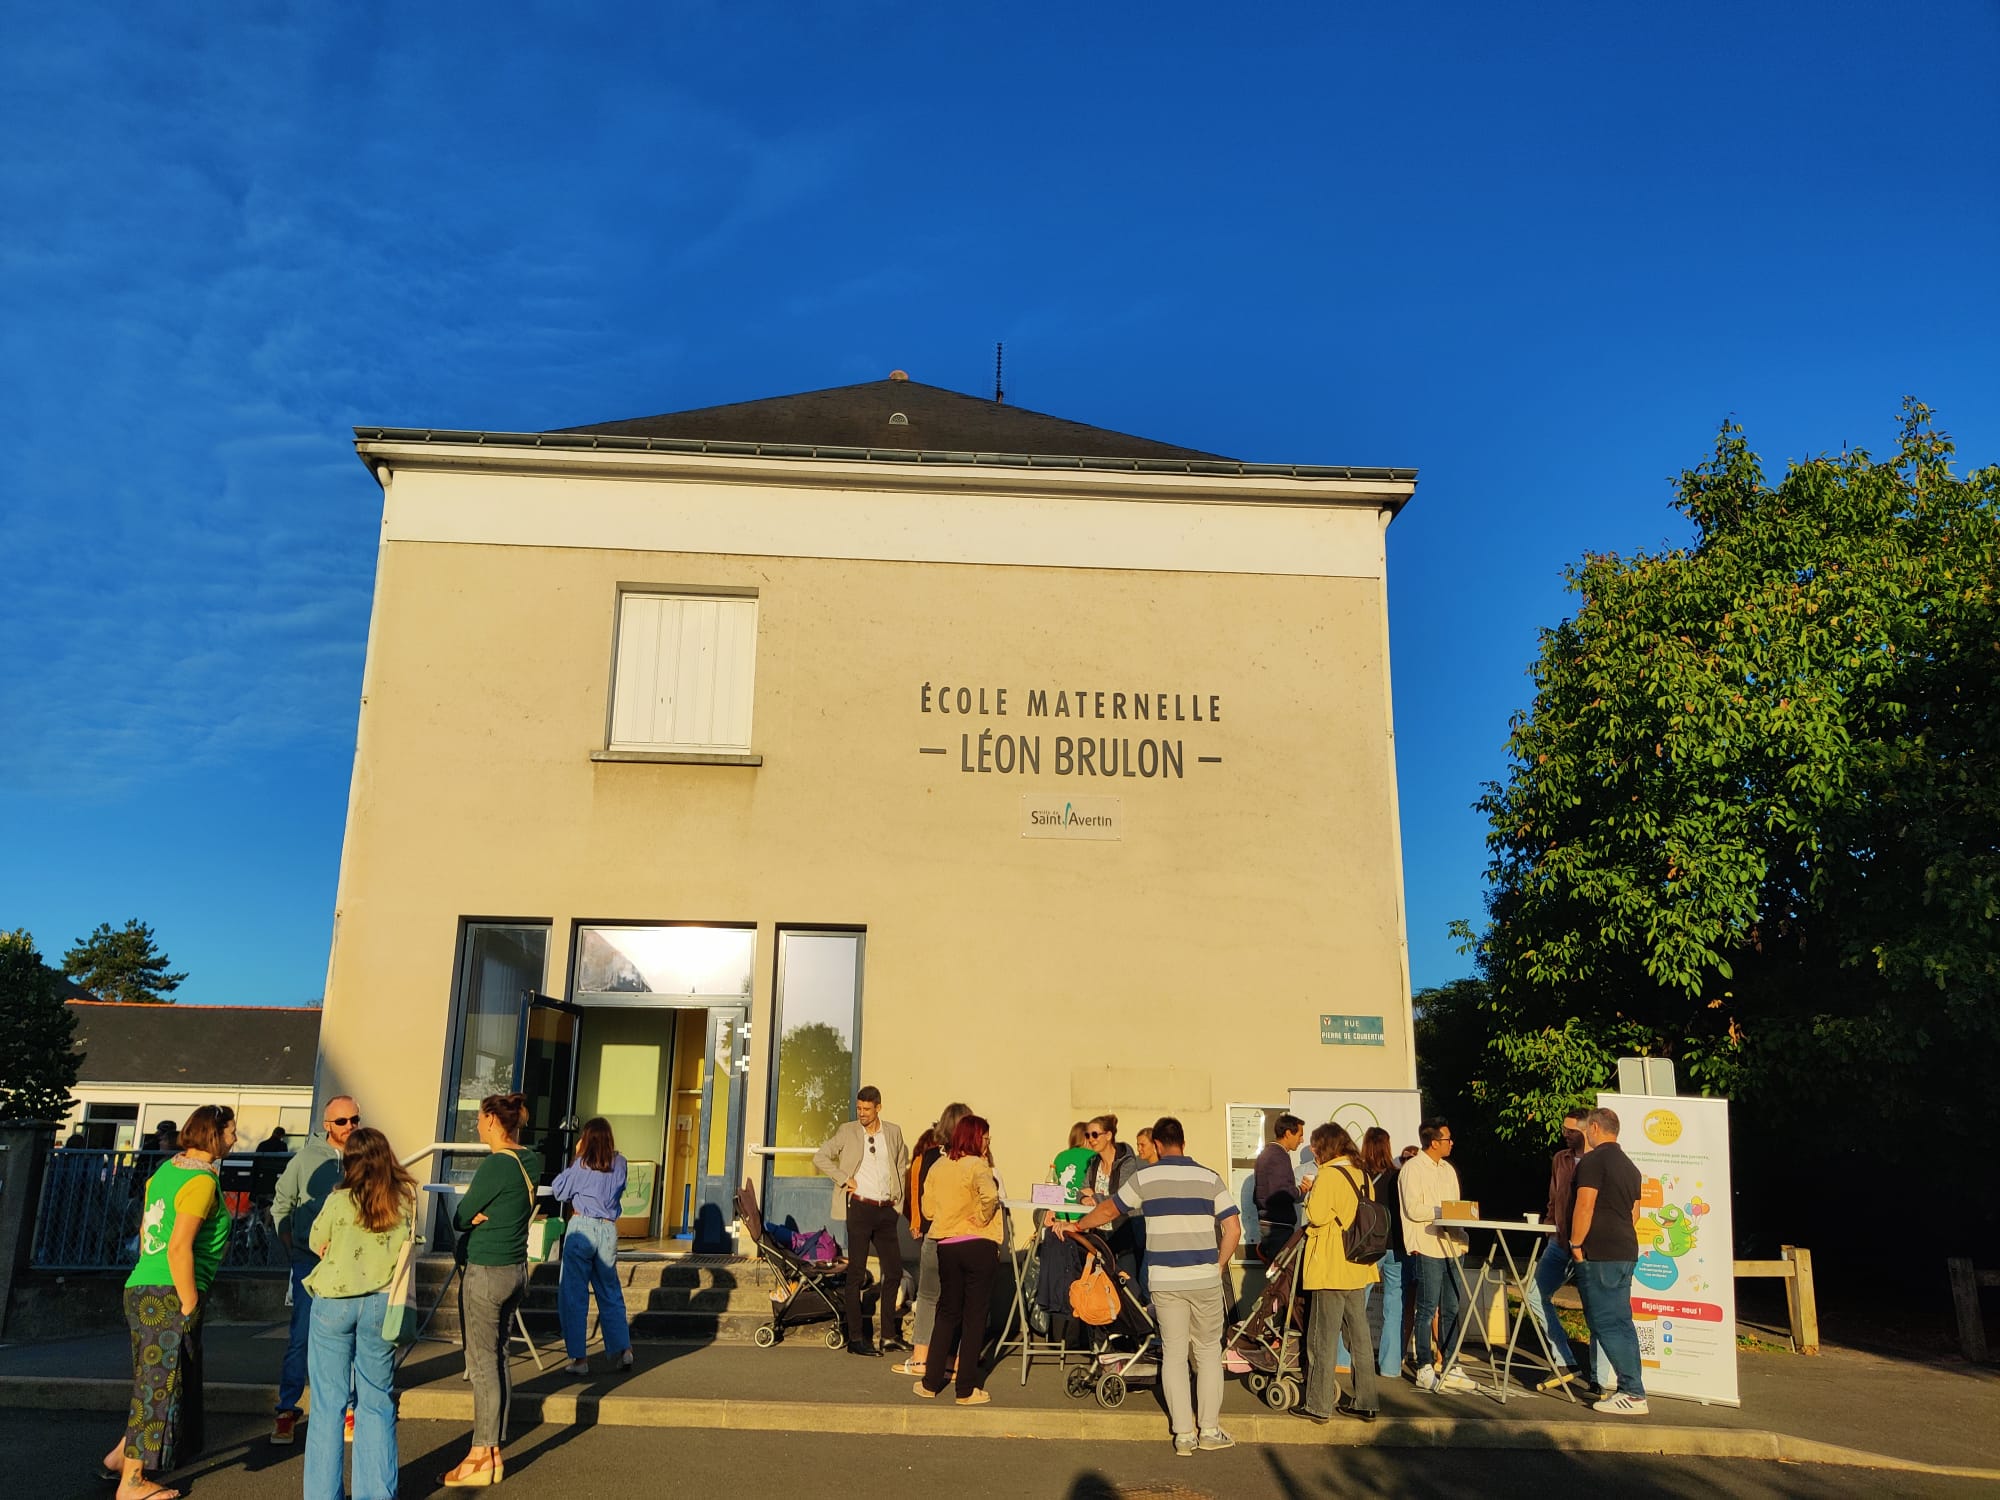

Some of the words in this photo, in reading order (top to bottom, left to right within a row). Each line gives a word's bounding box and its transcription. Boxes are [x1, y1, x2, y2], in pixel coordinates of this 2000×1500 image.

[920, 682, 1007, 716] ÉCOLE
[1026, 689, 1221, 722] MATERNELLE
[961, 728, 1040, 775] LÉON
[1054, 736, 1184, 779] BRULON
[1031, 810, 1061, 825] Saint
[1068, 811, 1112, 827] Avertin
[1344, 1019, 1360, 1027] RUE
